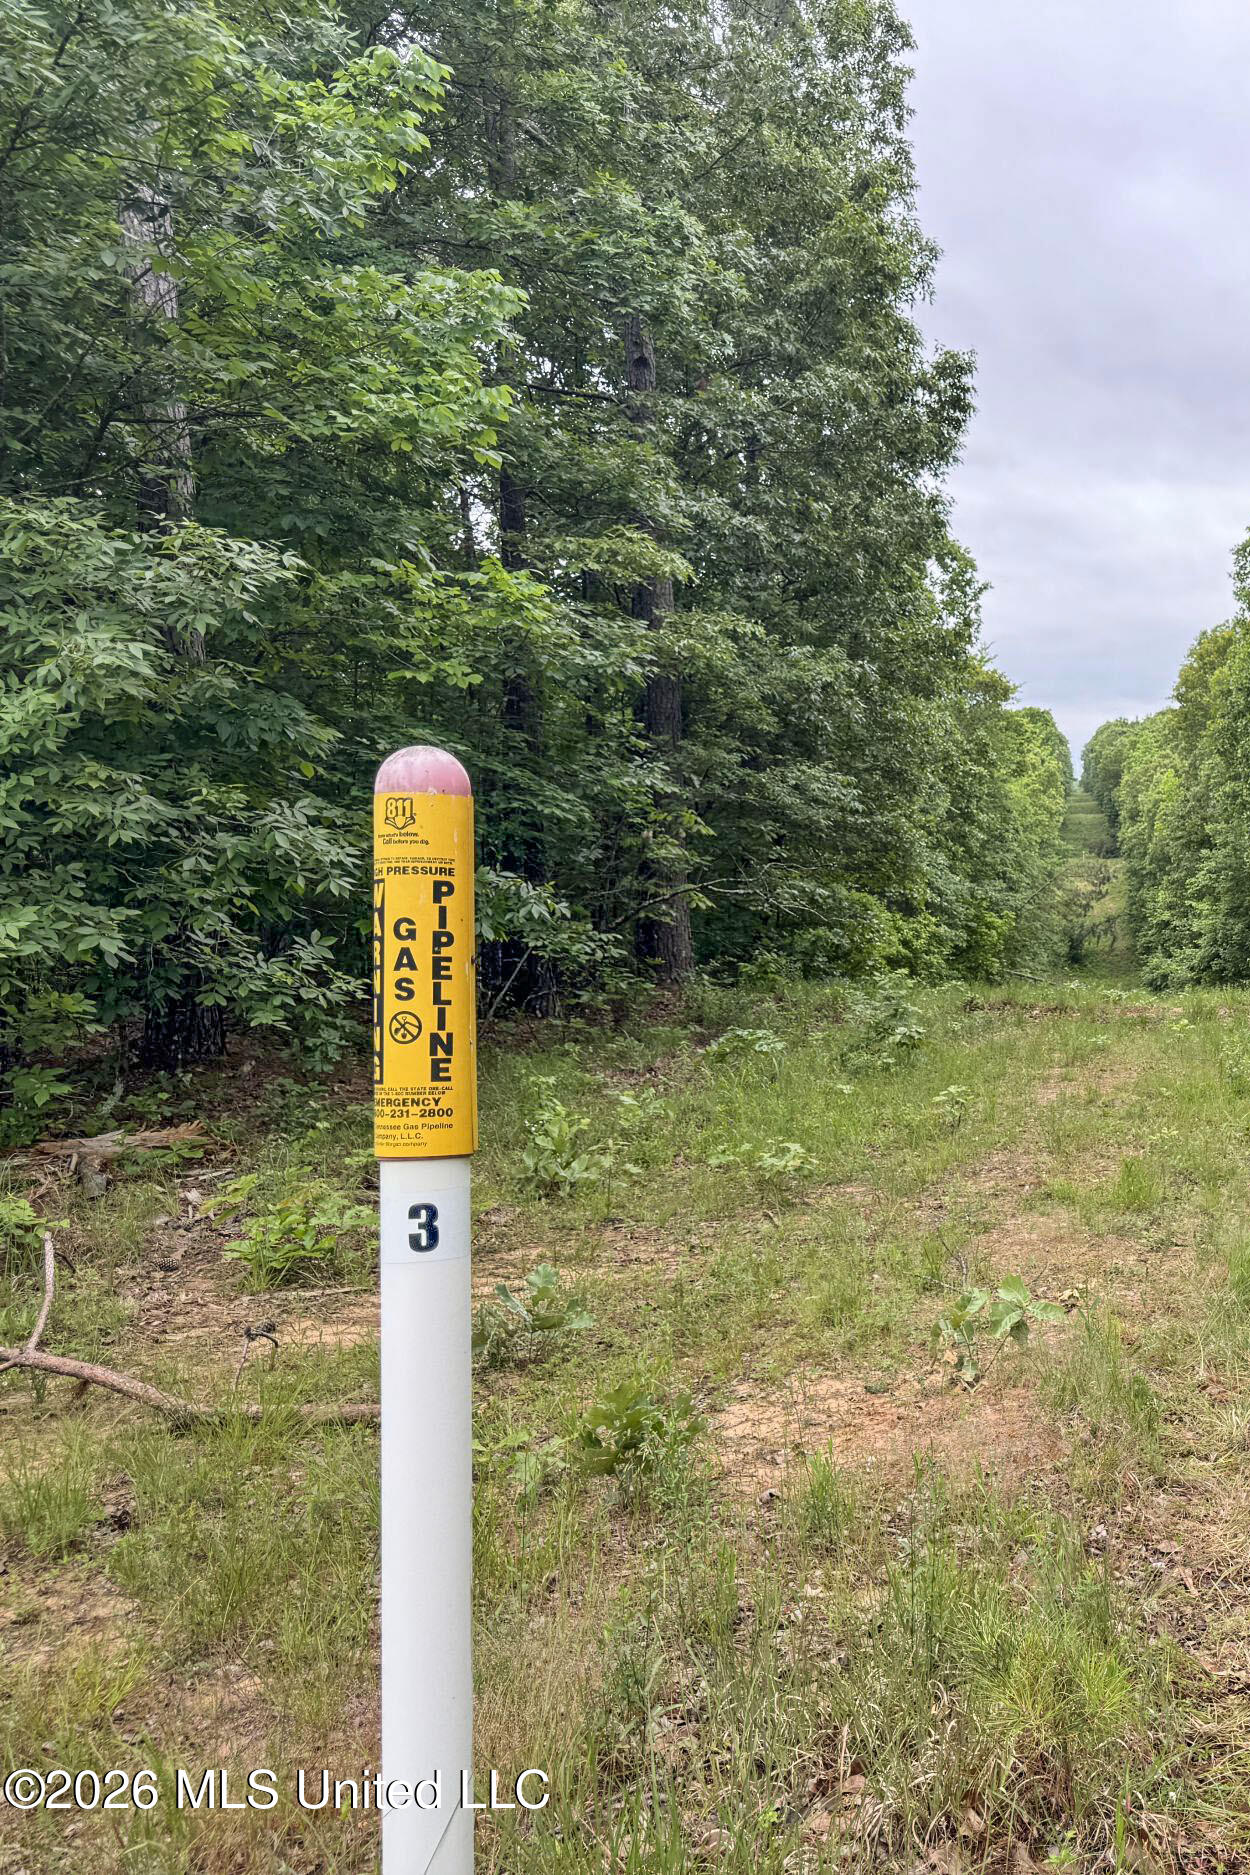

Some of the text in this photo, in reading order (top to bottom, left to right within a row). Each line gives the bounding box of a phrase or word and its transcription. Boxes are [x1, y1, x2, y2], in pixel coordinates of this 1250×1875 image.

[385, 797, 414, 819] 811
[386, 866, 455, 877] PRESSURE
[393, 917, 419, 1001] GAS
[430, 879, 455, 1083] PIPELINE
[375, 1097, 441, 1107] MERGENCY
[421, 1122, 453, 1131] Pipeline
[408, 1202, 440, 1254] 3
